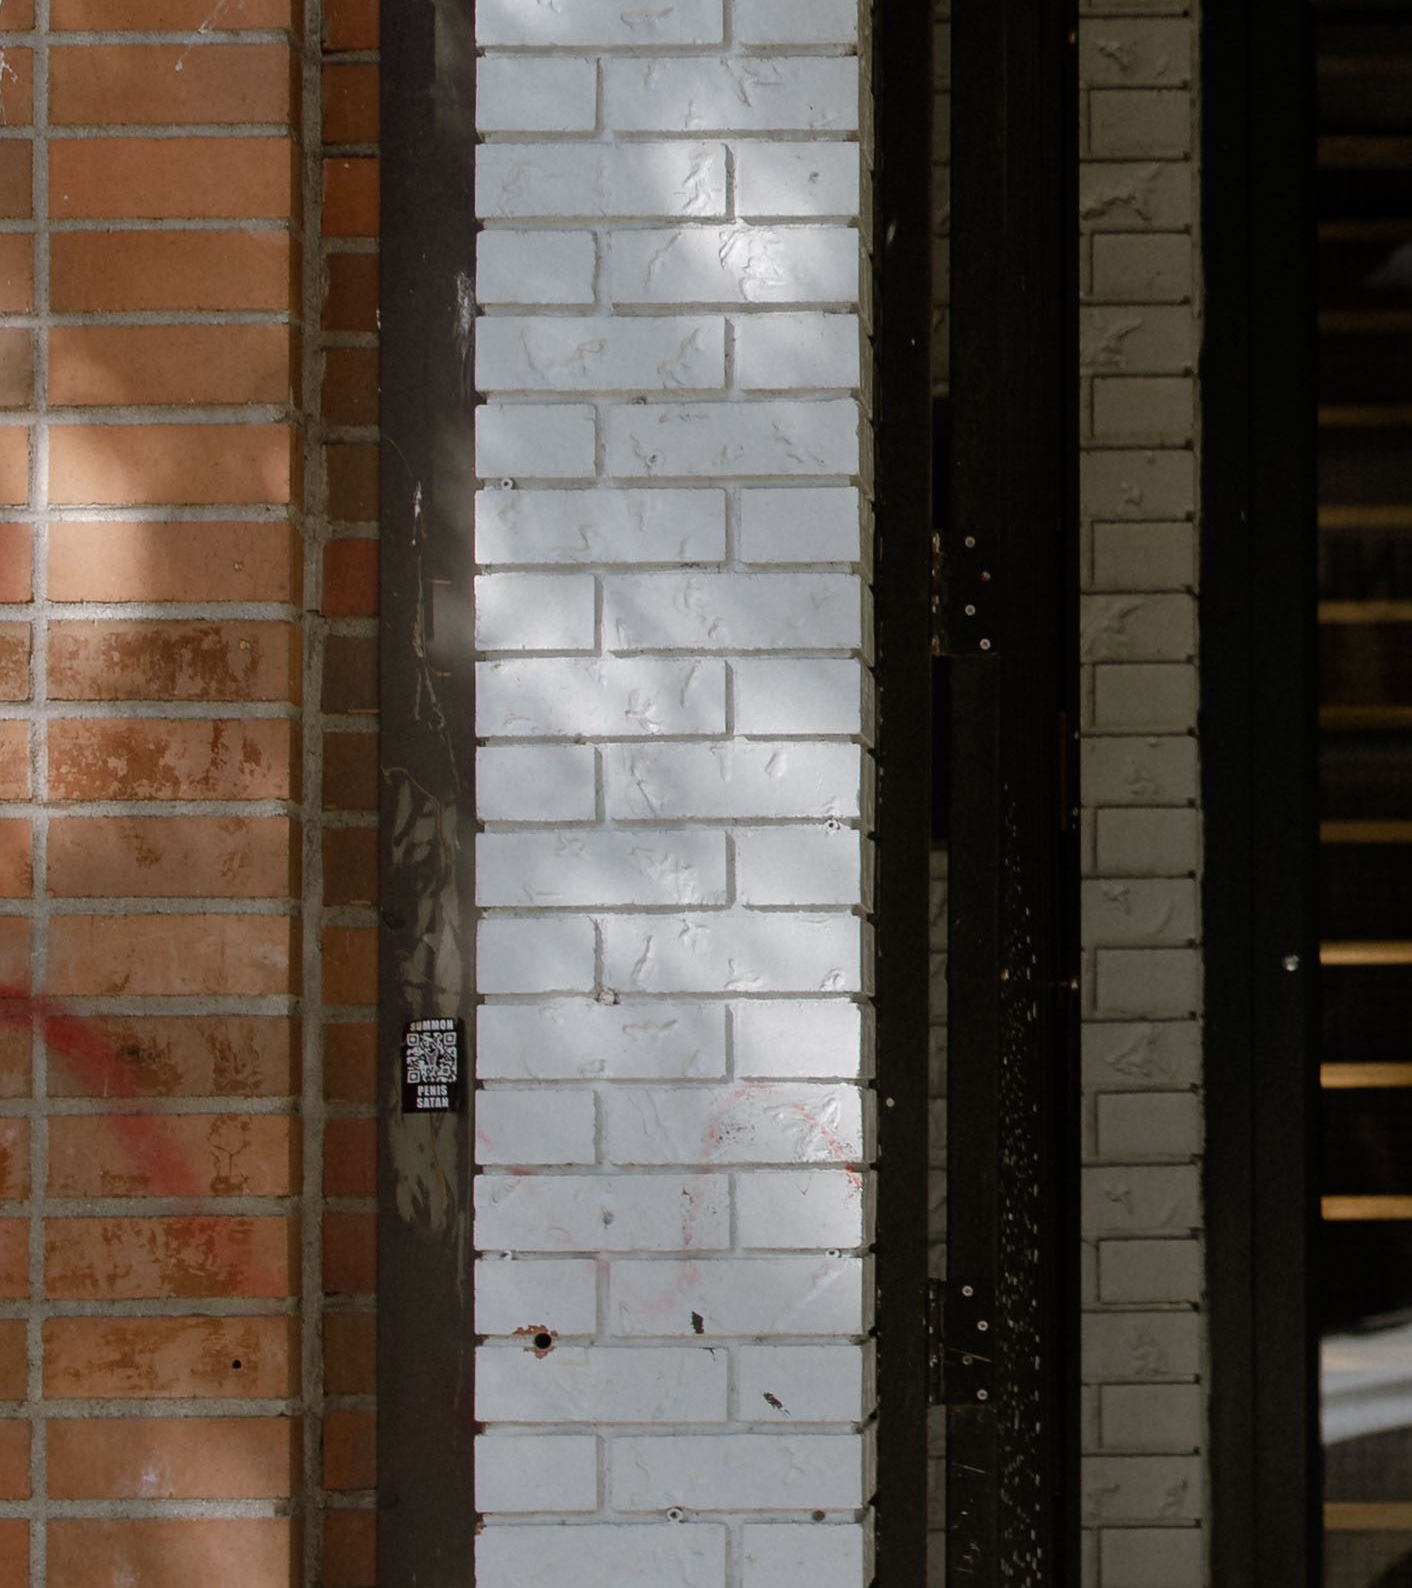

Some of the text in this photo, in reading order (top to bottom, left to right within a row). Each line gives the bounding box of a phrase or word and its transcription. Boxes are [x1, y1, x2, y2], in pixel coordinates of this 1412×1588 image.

[409, 1019, 455, 1032] SUMMON
[417, 1085, 448, 1097] PENIS
[416, 1097, 449, 1109] SATAN
